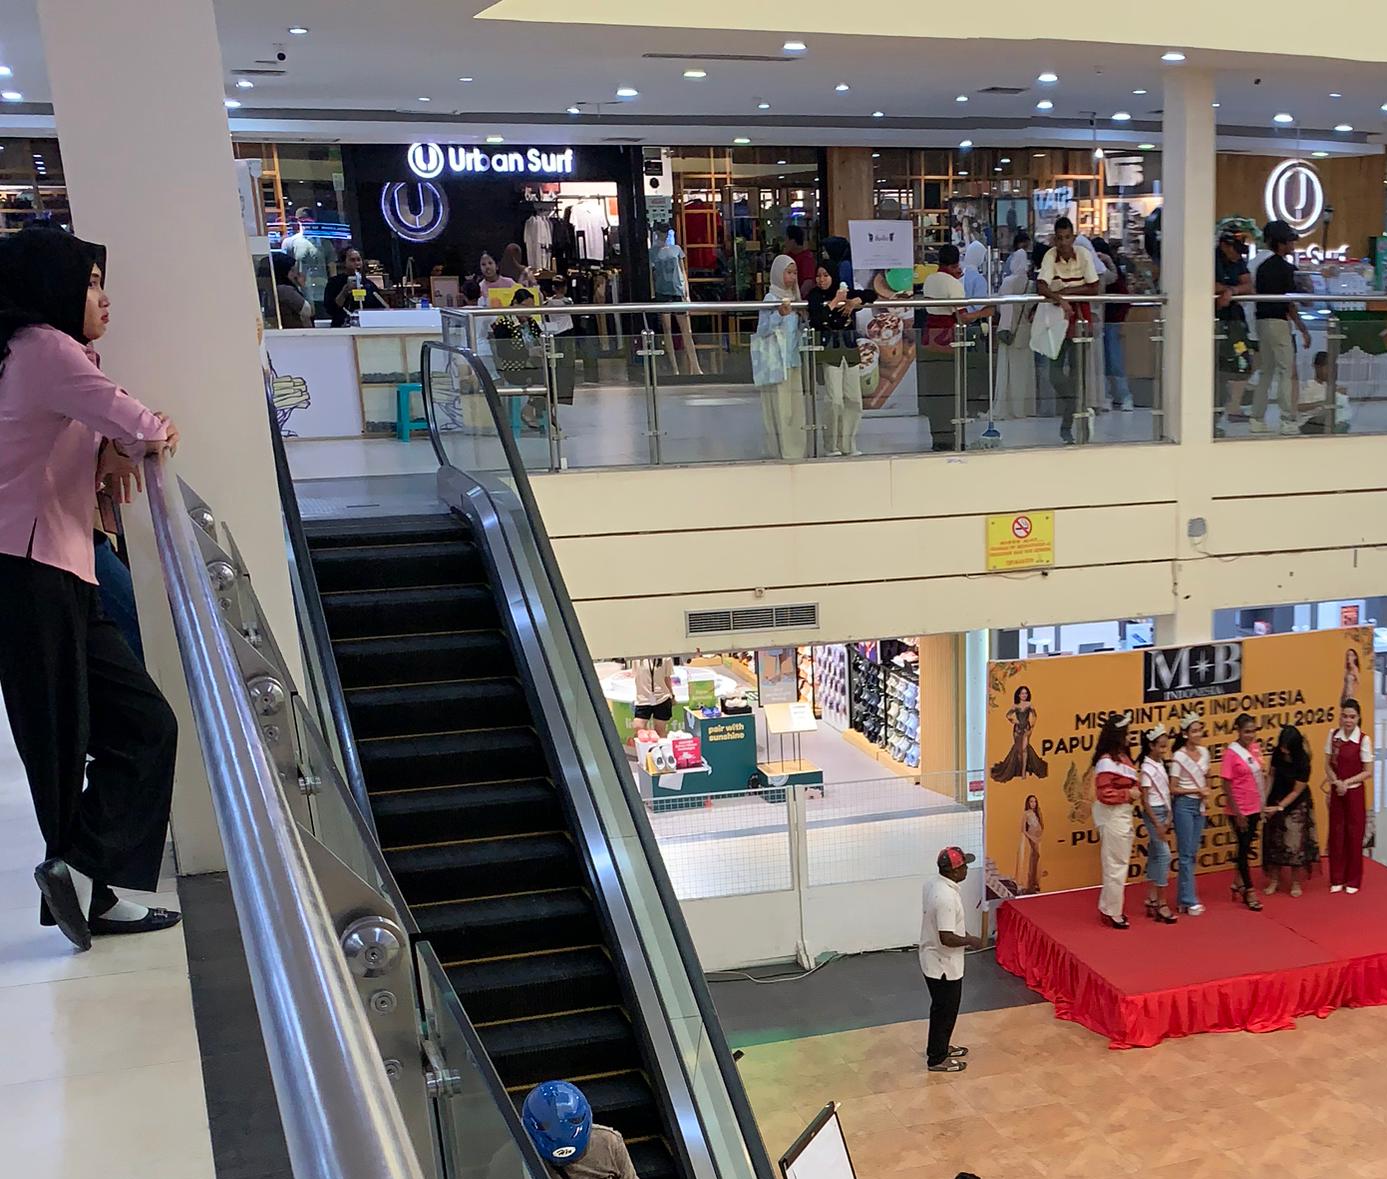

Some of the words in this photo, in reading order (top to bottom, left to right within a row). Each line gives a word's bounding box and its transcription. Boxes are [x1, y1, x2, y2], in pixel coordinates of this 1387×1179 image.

[449, 146, 524, 172] Urban
[527, 148, 574, 173] Surf
[1210, 689, 1306, 715] INDONESIA
[1294, 706, 1335, 727] 2026
